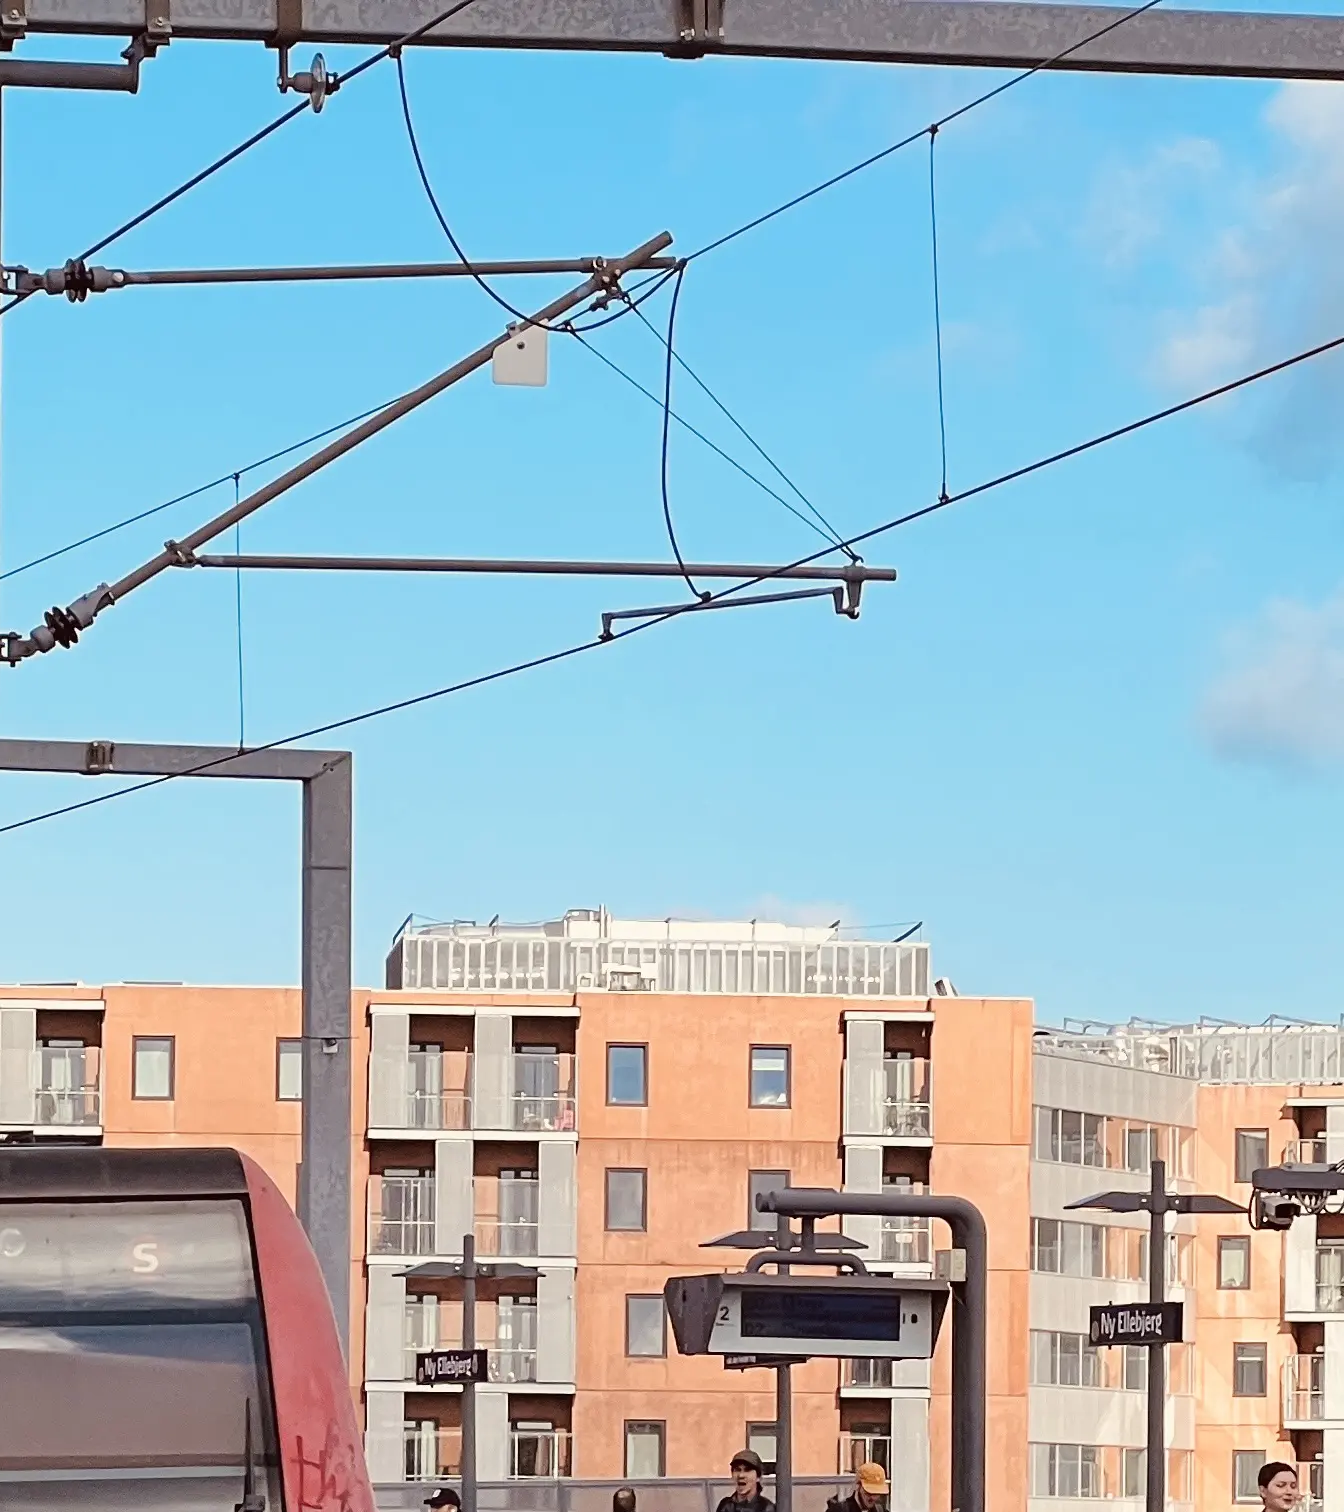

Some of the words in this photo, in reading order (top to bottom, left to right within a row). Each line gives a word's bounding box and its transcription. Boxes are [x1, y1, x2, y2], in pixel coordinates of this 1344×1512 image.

[719, 1306, 730, 1321] 2
[1100, 1312, 1116, 1340] Ny
[1117, 1309, 1163, 1338] Ellebjerg
